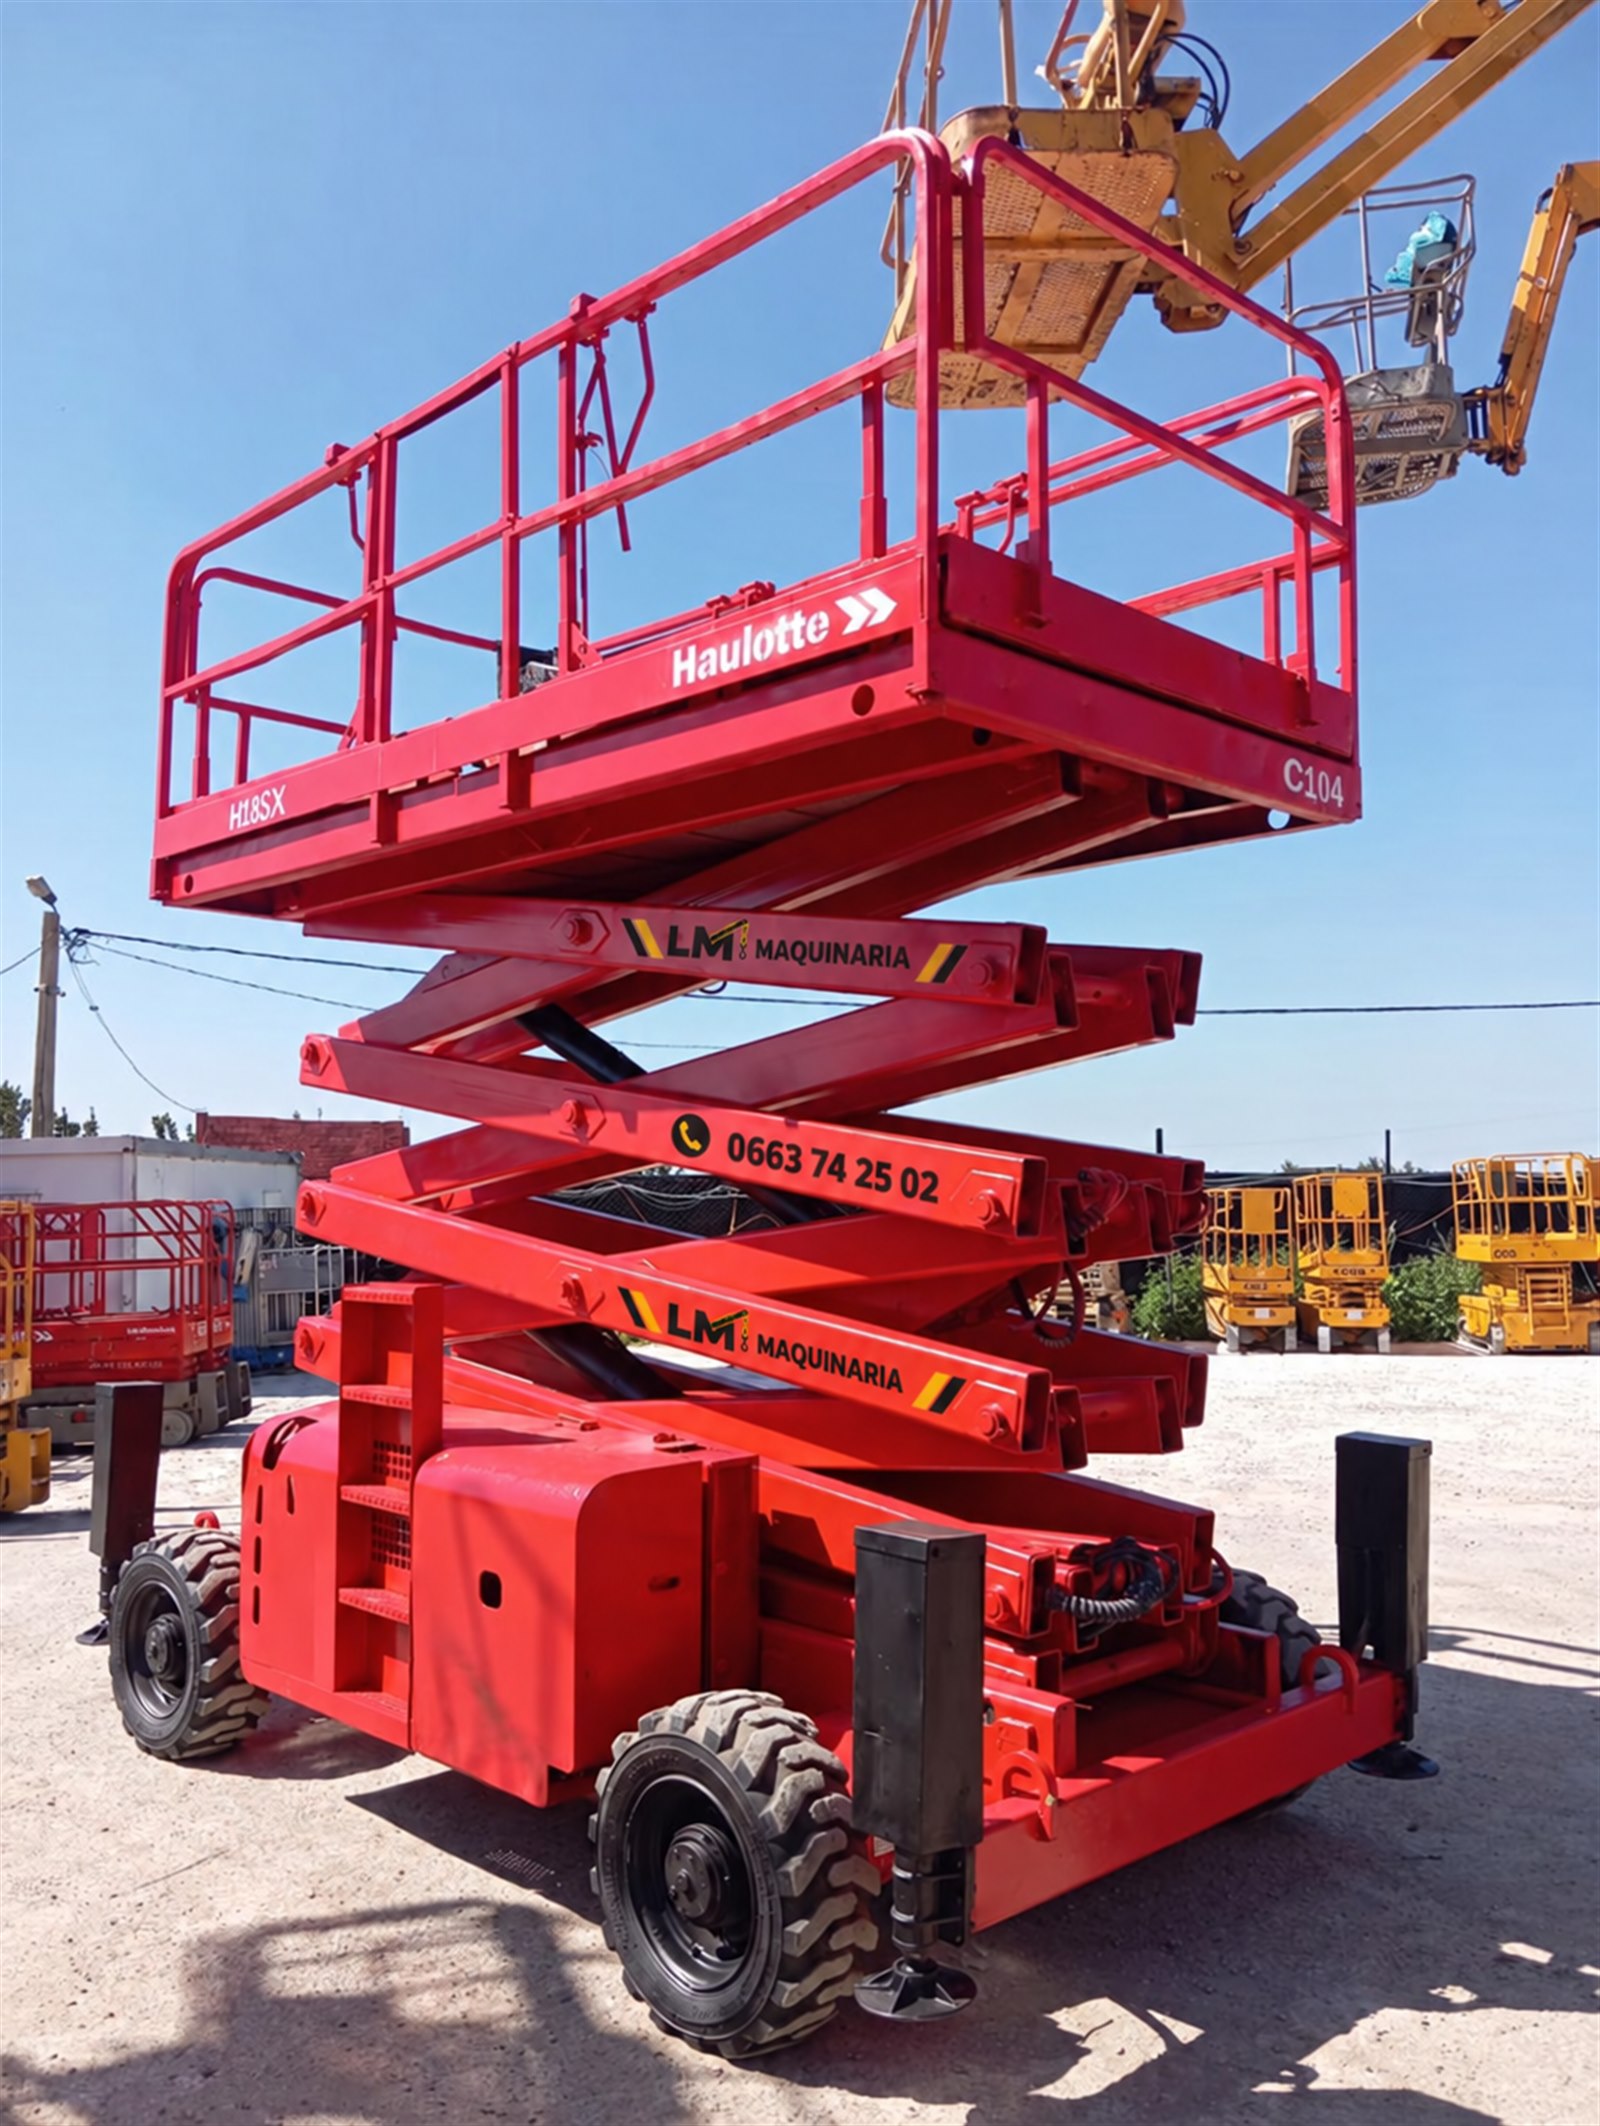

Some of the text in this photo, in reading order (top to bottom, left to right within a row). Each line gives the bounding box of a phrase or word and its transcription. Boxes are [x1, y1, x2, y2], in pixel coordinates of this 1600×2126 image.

[672, 607, 830, 688] Haulotte
[228, 784, 287, 831] H18SX
[1283, 757, 1344, 808] C104
[667, 924, 911, 970] LM MAQUINARIA
[727, 1132, 939, 1204] 0663 74 25 02
[667, 1302, 904, 1394] LM MAQUINARIA
